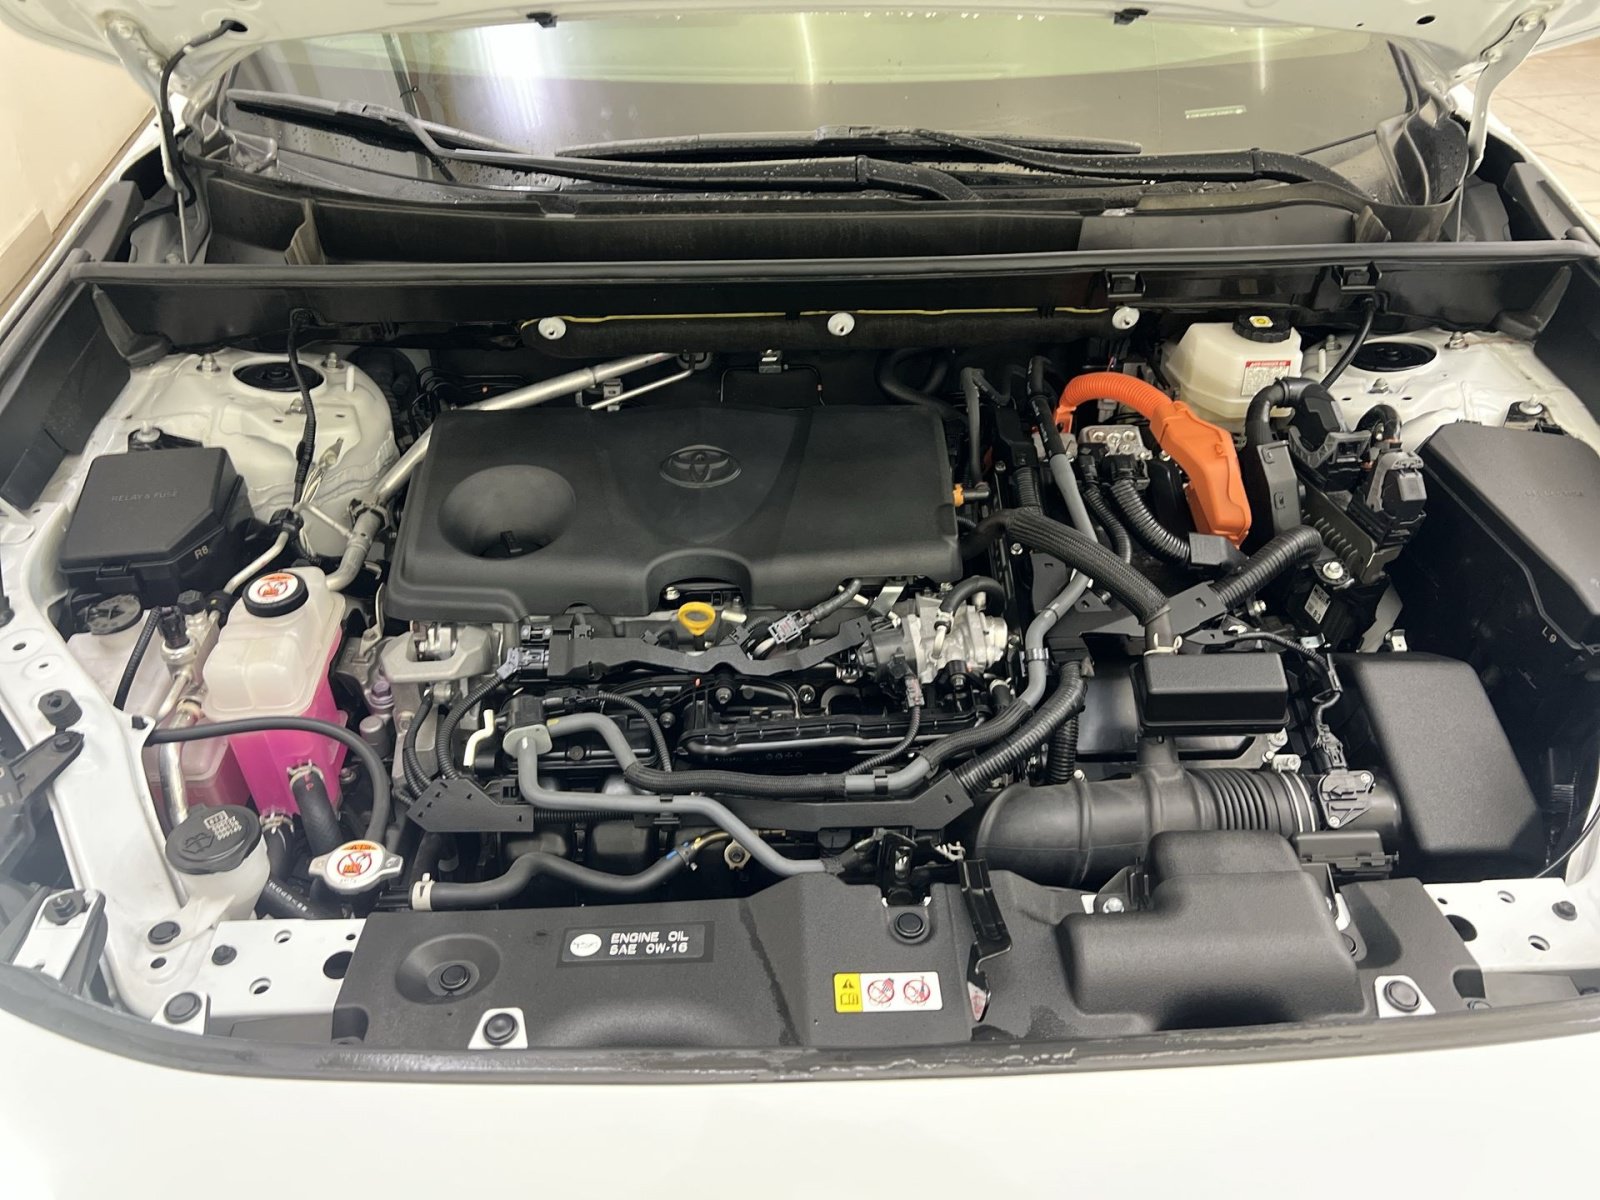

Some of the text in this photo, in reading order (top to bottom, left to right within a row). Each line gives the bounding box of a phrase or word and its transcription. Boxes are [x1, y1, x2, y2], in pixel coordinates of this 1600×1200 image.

[610, 930, 690, 944] ENGINE OIL
[609, 943, 638, 956] SAE
